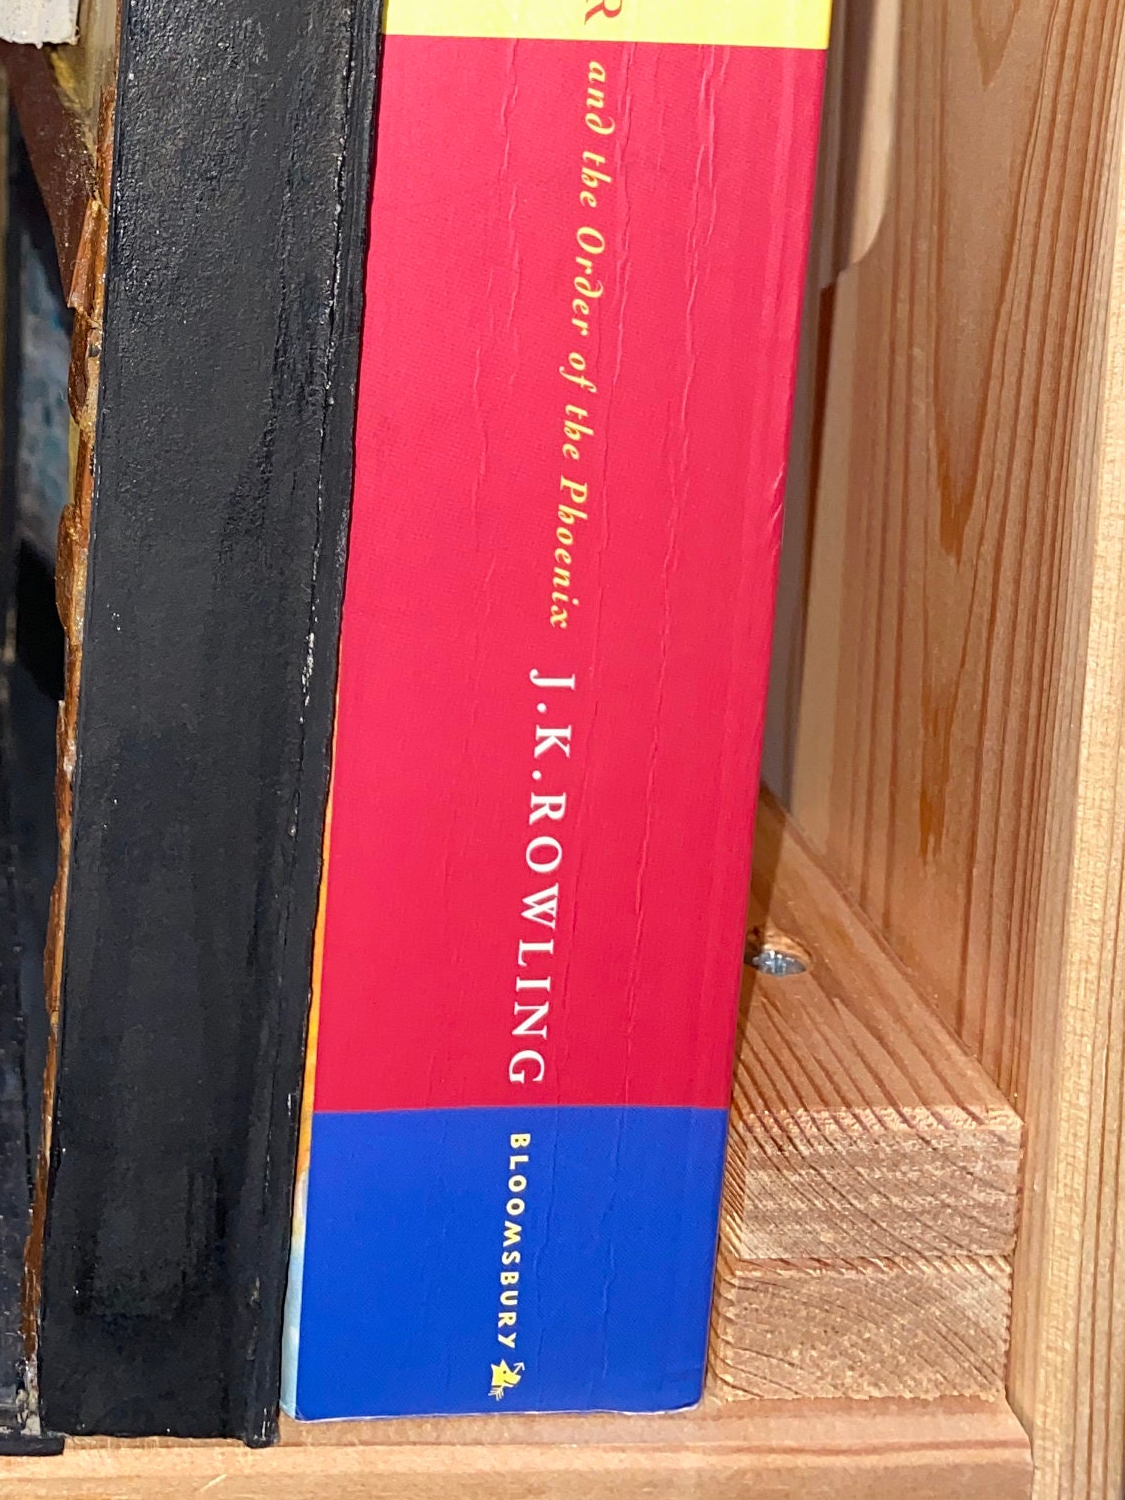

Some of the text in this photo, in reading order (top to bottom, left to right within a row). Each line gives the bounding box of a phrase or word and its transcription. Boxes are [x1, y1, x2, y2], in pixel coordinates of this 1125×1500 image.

[585, 60, 616, 137] and
[579, 149, 613, 209] the
[571, 225, 607, 337] Order
[559, 351, 597, 394] of
[561, 401, 595, 461] the
[549, 474, 589, 630] Phoenix
[498, 1131, 532, 1350] BLOOMSBURY
